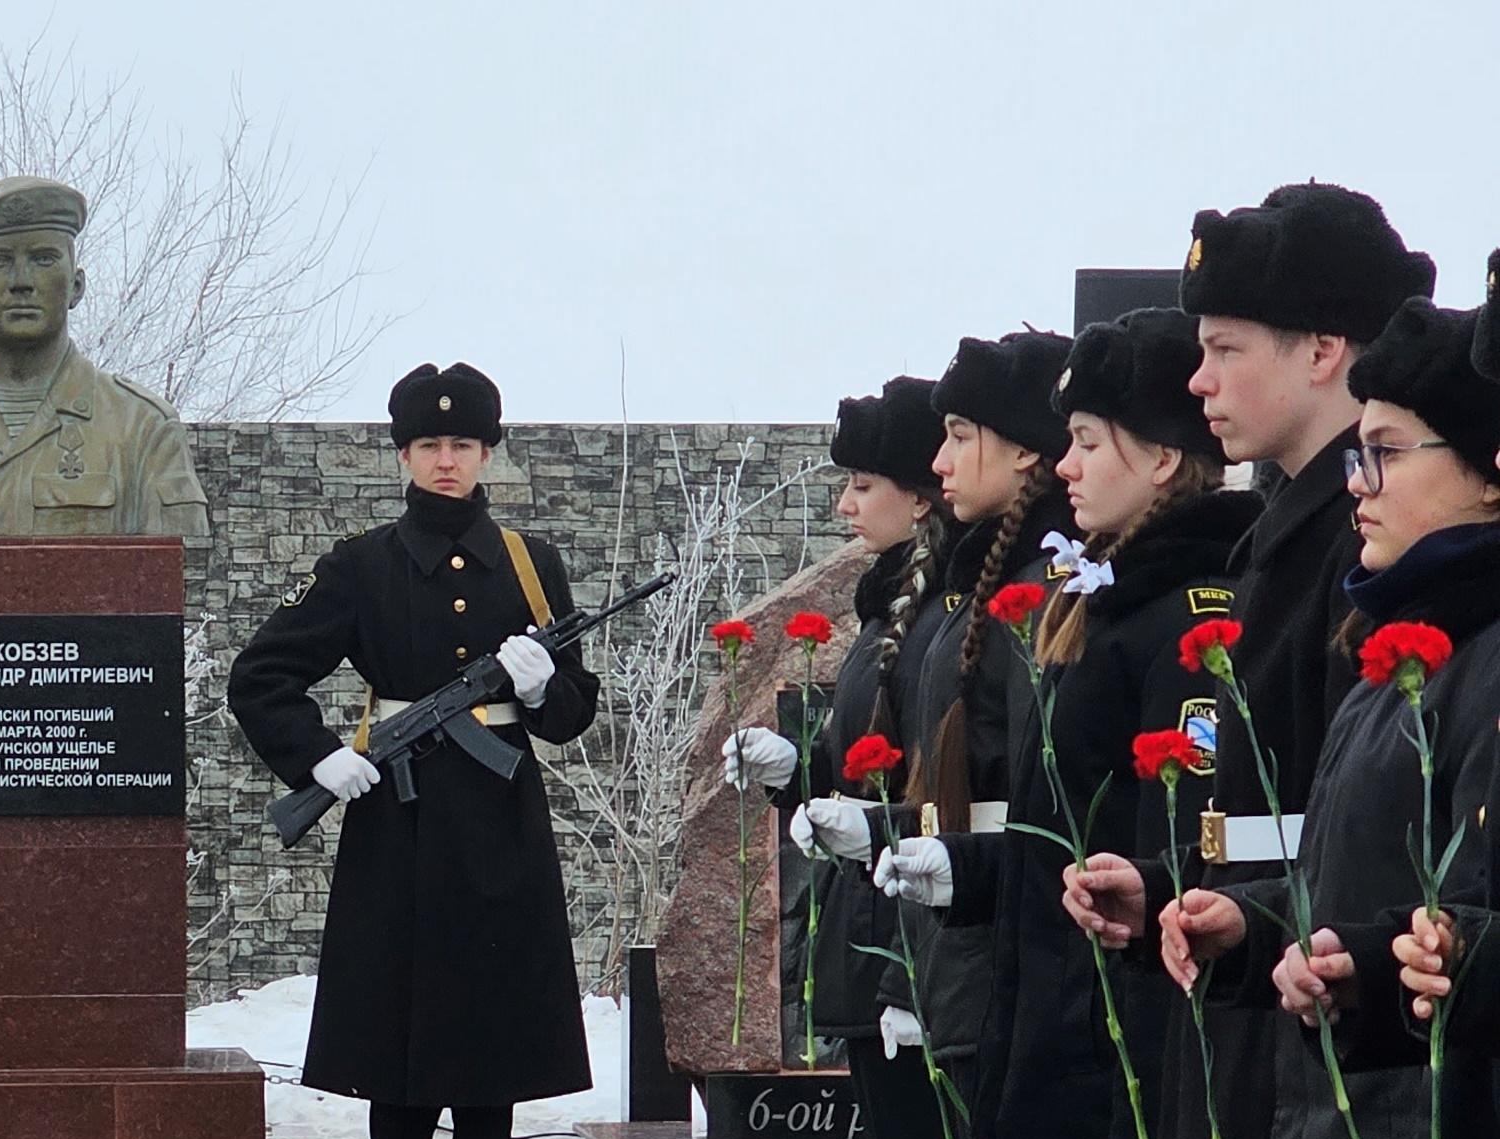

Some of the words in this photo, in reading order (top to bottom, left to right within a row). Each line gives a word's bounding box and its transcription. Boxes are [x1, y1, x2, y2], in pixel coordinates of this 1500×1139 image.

[29, 667, 154, 687] ДМИТРИЕВИЧ
[33, 706, 114, 722] ПОГИБШИЙ
[45, 726, 76, 738] 2000
[79, 727, 88, 738] г.
[56, 741, 116, 756] УЩЕЛЬЕ
[4, 757, 100, 773] ПРОВЕДЕНИИ
[95, 773, 172, 789] ОПЕРАЦИИ
[748, 1087, 836, 1132] 6-ой
